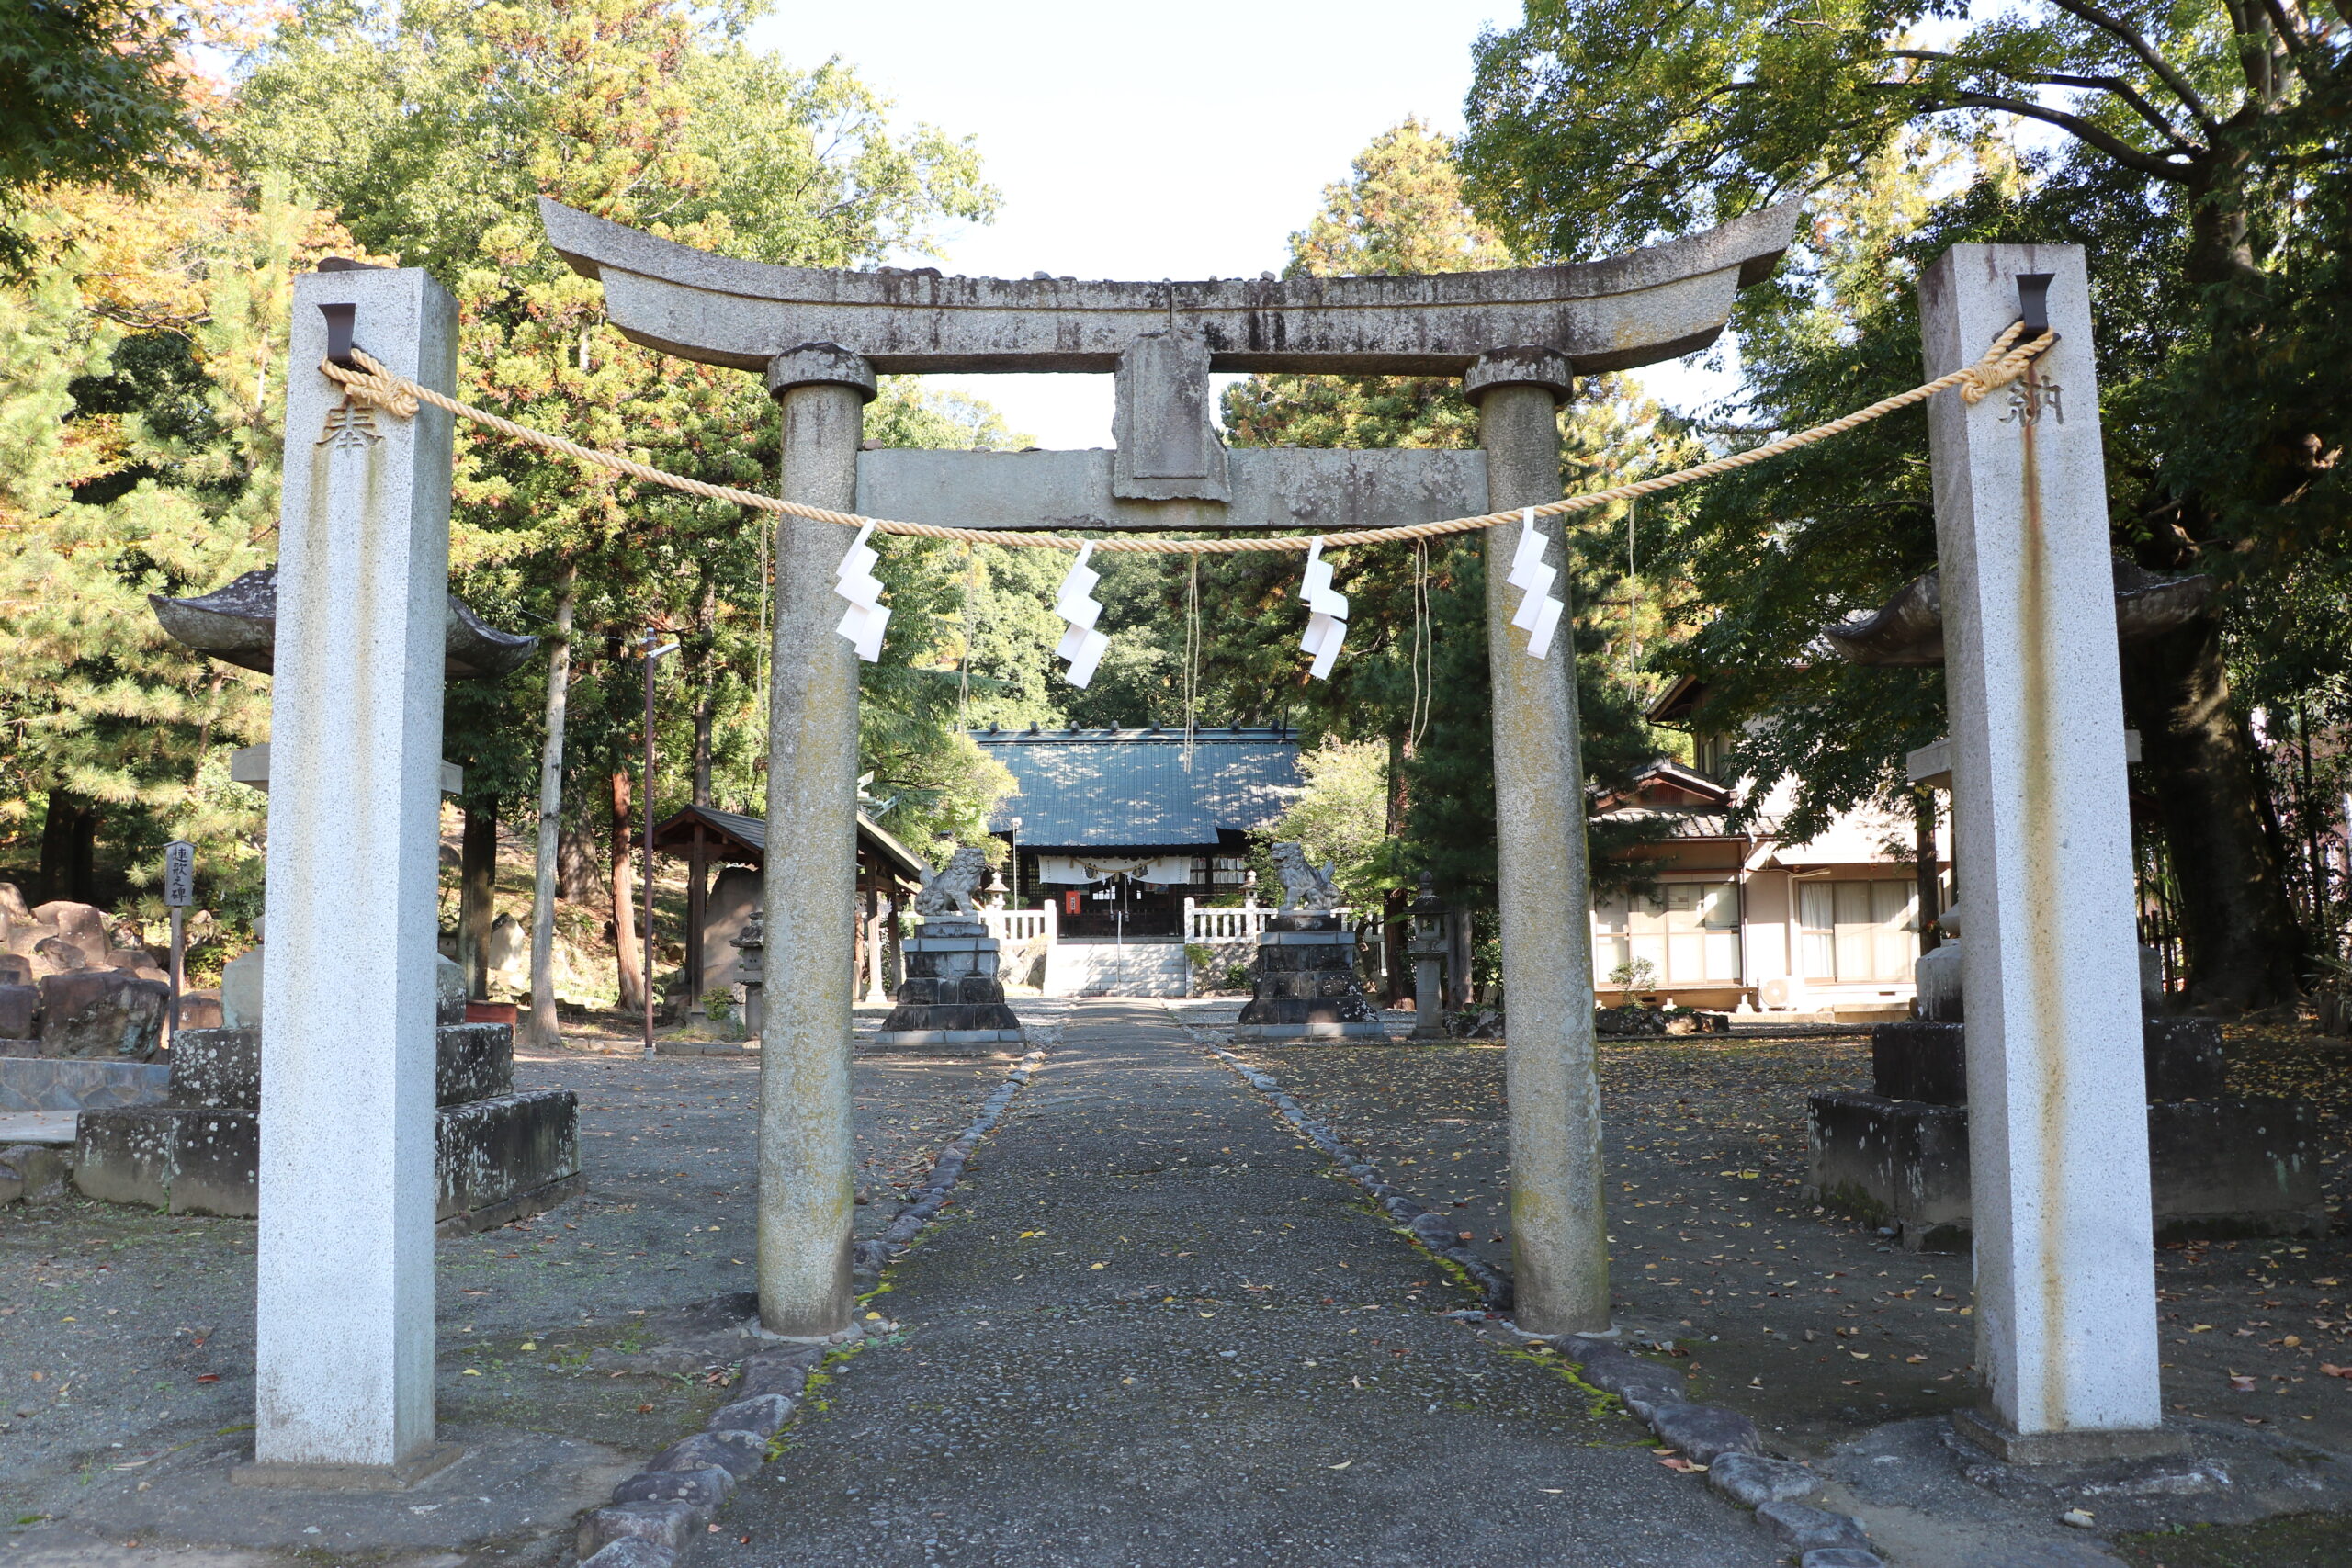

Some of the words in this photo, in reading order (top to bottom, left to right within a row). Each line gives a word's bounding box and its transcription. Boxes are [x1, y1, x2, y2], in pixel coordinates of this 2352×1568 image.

[314, 394, 385, 457] 奉
[1998, 374, 2064, 428] 納
[171, 846, 188, 903] 連歌之碑
